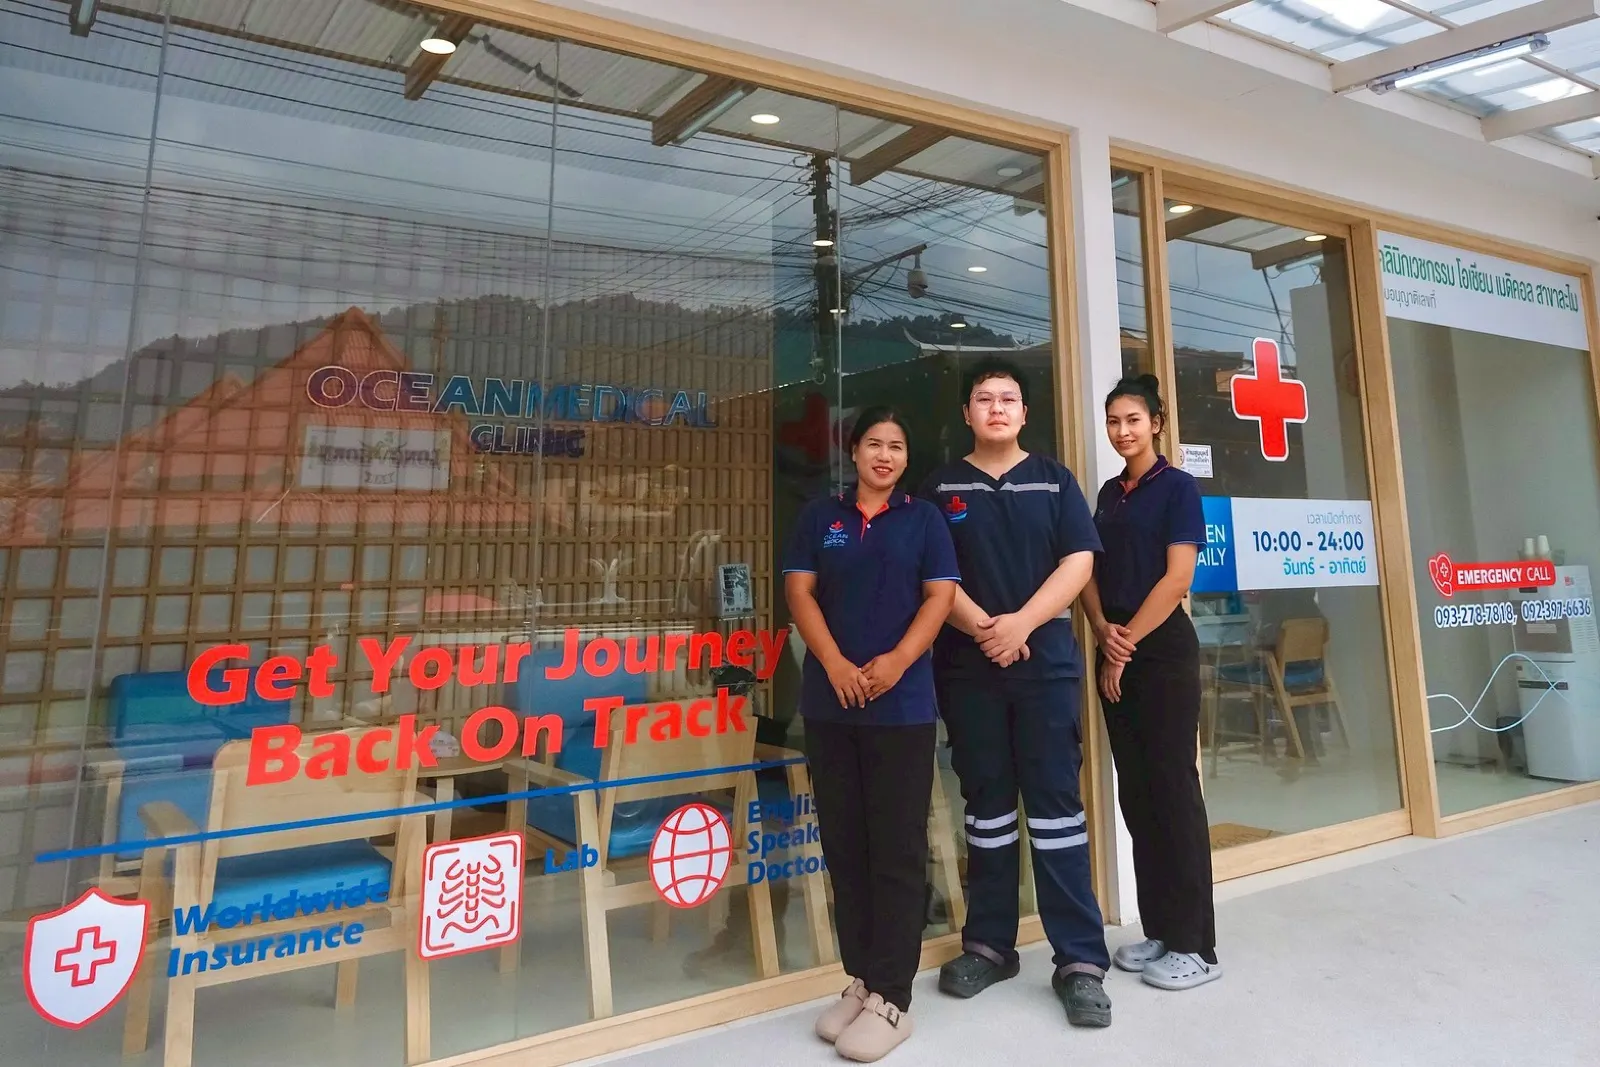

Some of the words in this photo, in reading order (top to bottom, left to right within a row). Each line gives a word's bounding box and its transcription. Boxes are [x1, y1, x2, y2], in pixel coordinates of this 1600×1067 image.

[1383, 288, 1437, 308] บอนุญาติเลขที่
[1495, 272, 1534, 303] เมดิคอล
[1536, 283, 1579, 313] สาขาละไม
[470, 423, 586, 458] CLINIC
[1205, 524, 1226, 543] EN
[1306, 510, 1363, 525] เวลาเปิดทำการ
[1196, 547, 1227, 566] AILY
[1252, 530, 1301, 552] 10:00
[1317, 530, 1364, 552] 24:00
[1283, 556, 1315, 576] จันทร์
[1329, 556, 1367, 574] อาทิตย์
[1457, 568, 1522, 585] EMERGENCY
[1526, 566, 1551, 582] CALL
[1435, 602, 1517, 627] 093-278-7818,
[1521, 599, 1591, 621] 092-397-6636
[186, 644, 338, 706] Get
[358, 636, 532, 693] Your
[545, 628, 790, 681] Journey
[246, 711, 443, 786] Back
[460, 706, 563, 762] On
[583, 687, 749, 749] Track
[747, 793, 818, 827] Engli
[746, 822, 821, 860] Speak
[543, 843, 600, 875] Lab
[172, 877, 391, 937] Worldwide
[166, 921, 365, 978] Insurance
